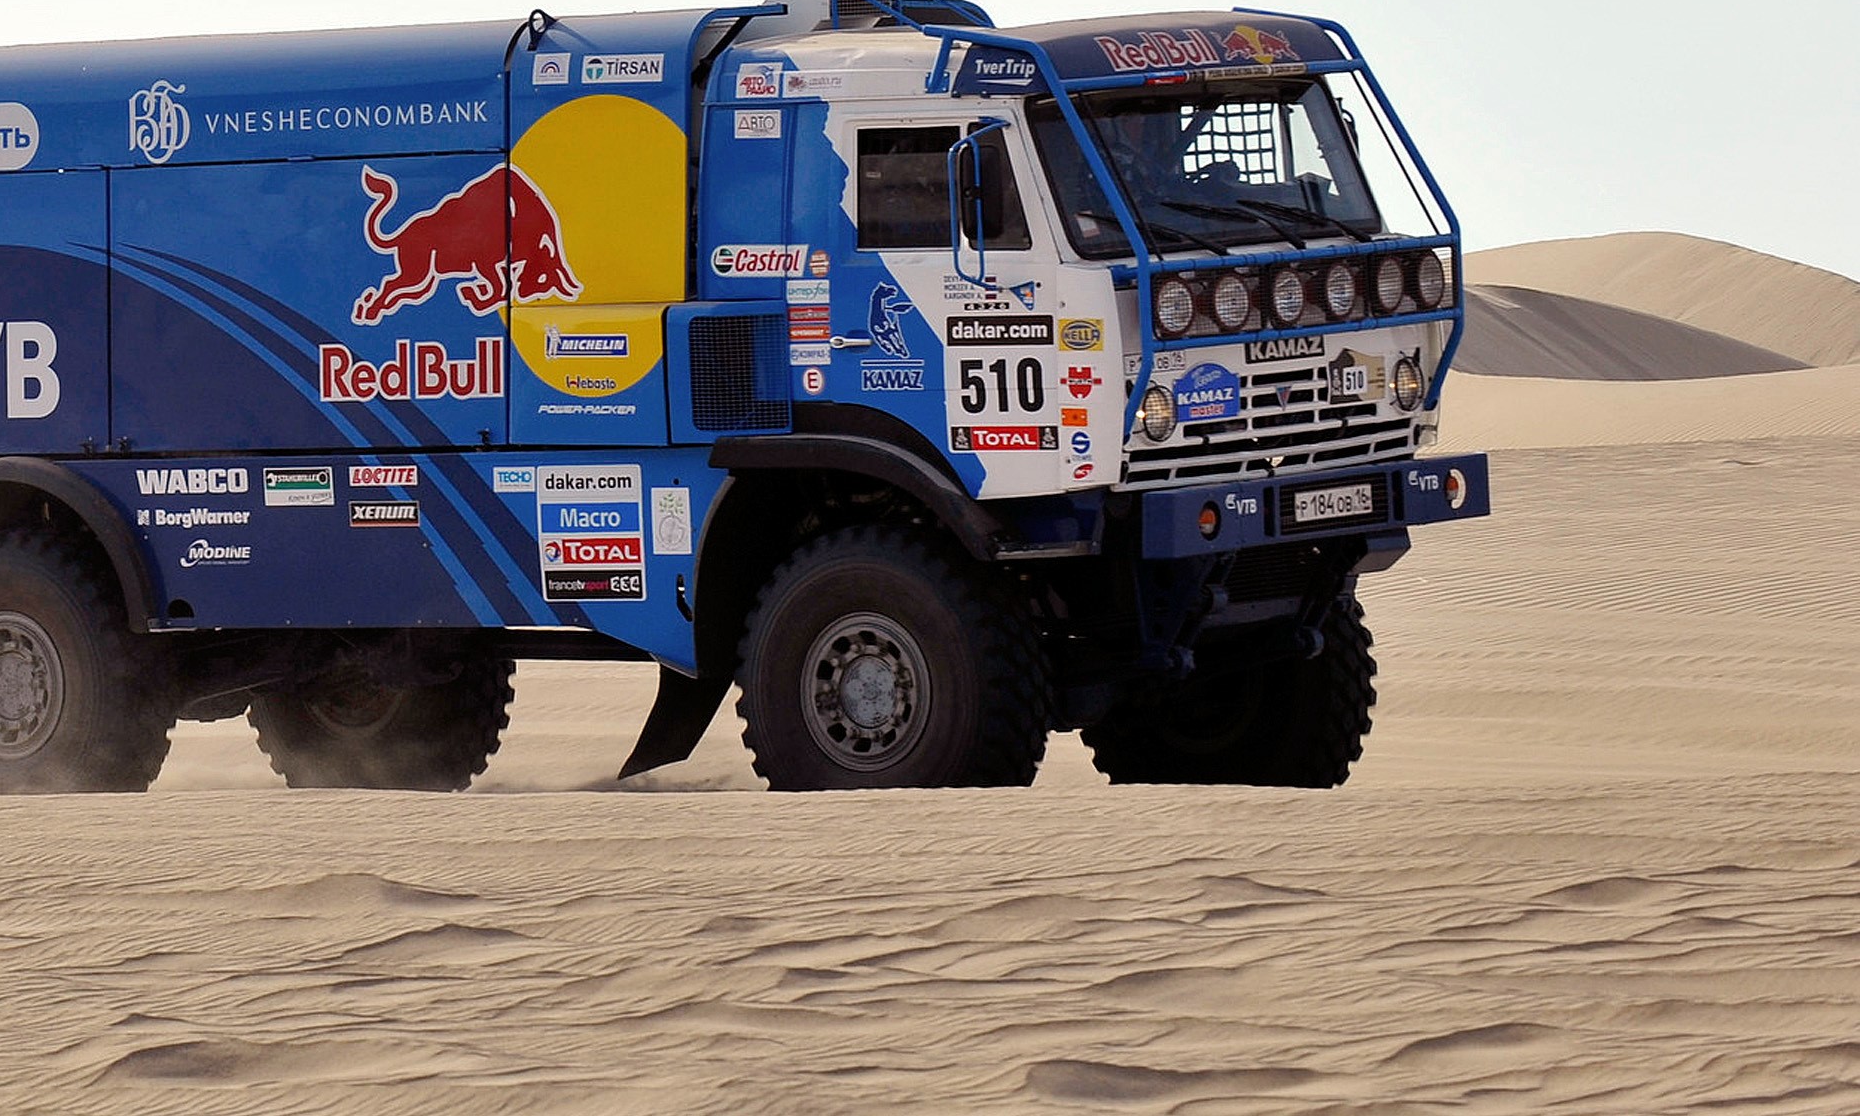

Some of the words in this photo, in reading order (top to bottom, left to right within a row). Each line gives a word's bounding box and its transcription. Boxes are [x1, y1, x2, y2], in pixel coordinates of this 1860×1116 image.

[1094, 32, 1153, 71] Red
[1152, 28, 1220, 67] Bull
[975, 58, 1037, 79] TverTrip
[205, 100, 488, 134] VNESHECONOMBANK
[735, 249, 800, 272] Castrol
[951, 321, 1048, 339] dakar.com
[560, 339, 625, 350] MICHELIN
[1248, 334, 1322, 361] KAMAZ
[321, 340, 410, 401] Red
[416, 338, 504, 399] Bull
[566, 375, 617, 389] Webasto
[807, 372, 819, 389] E
[862, 370, 924, 391] KAMAZ
[960, 358, 1045, 414] 510
[1346, 370, 1364, 391] 510
[1177, 387, 1235, 405] KAMAZ
[973, 430, 1037, 445] TOTAL
[136, 468, 249, 495] WABCO
[352, 467, 416, 484] LOCTITE
[545, 473, 632, 490] dakar.com
[1419, 474, 1439, 491] VTB
[1237, 496, 1257, 515] VTB
[1311, 493, 1335, 516] 184
[1355, 488, 1369, 504] 16
[155, 508, 251, 529] BorgWarner
[560, 508, 621, 528] Macro
[189, 546, 251, 559] MODINE
[565, 541, 638, 561] TOTAL
